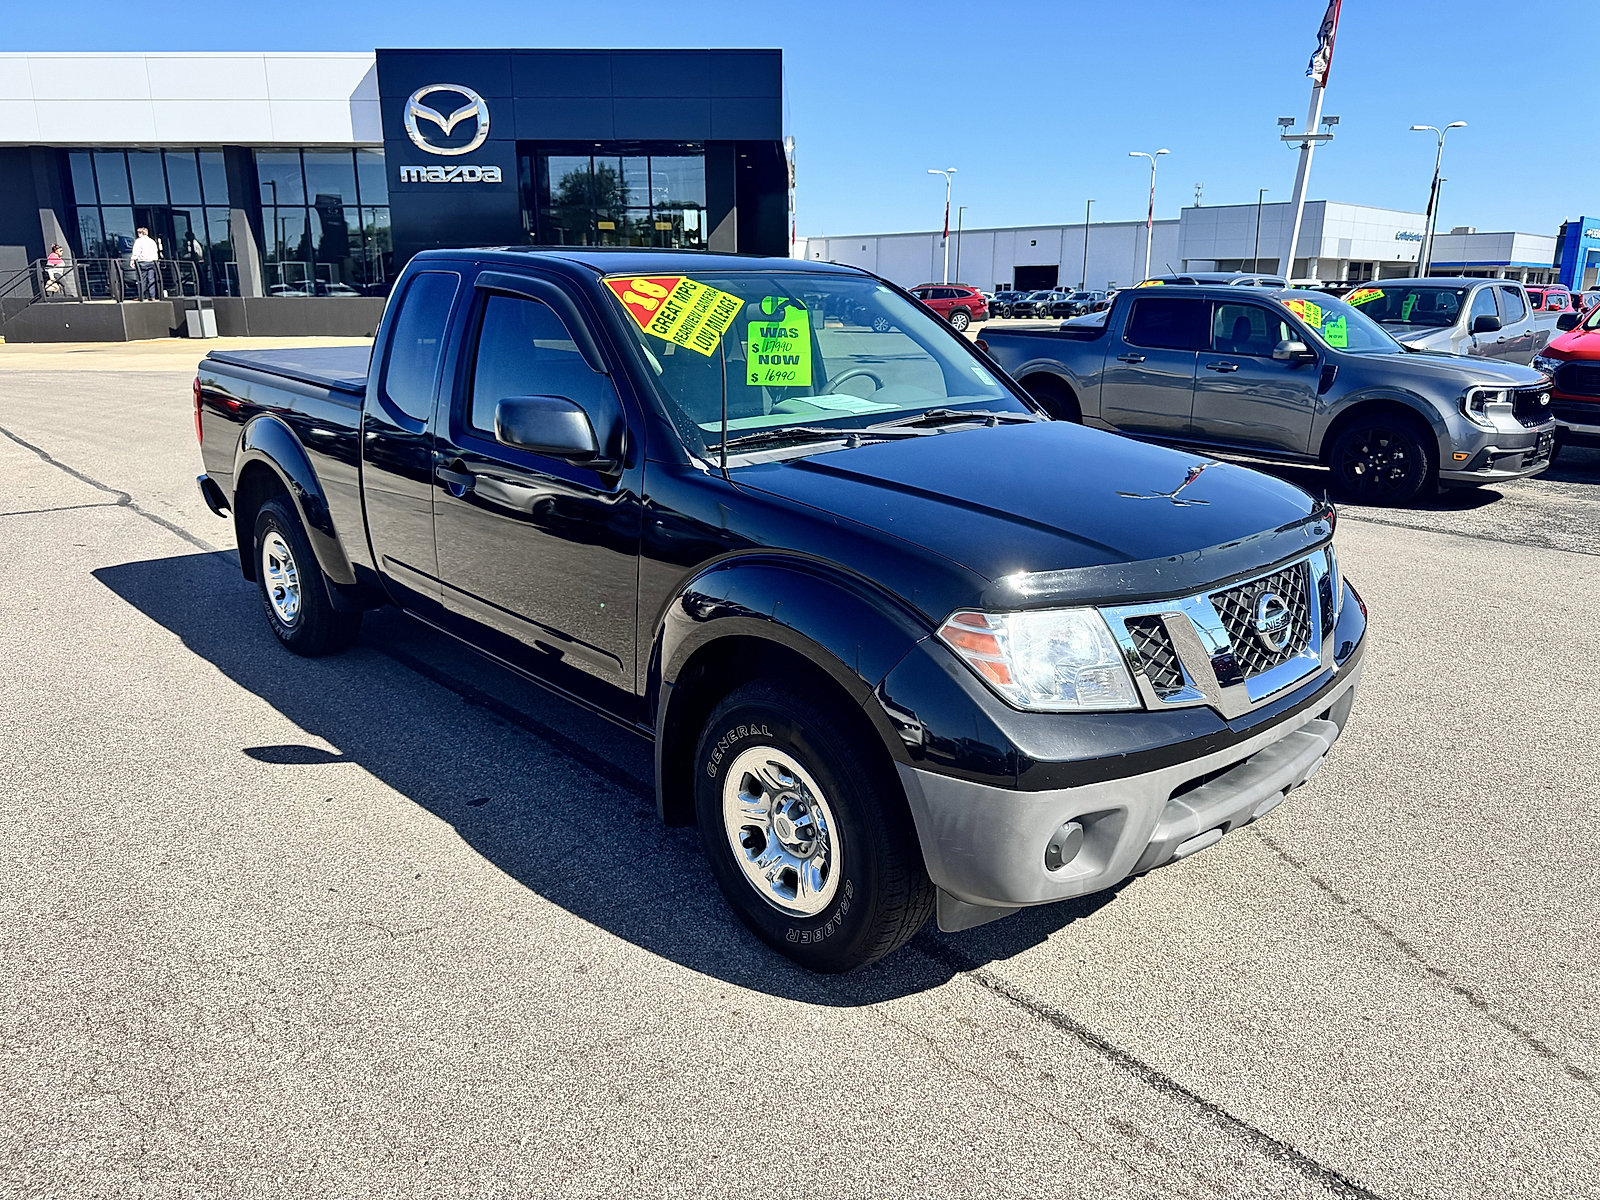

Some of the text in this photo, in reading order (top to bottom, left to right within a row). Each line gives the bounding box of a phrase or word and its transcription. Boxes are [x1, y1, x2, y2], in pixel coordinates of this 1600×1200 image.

[400, 165, 503, 183] mazda
[622, 279, 669, 311] 18
[651, 281, 698, 335] GREAT MPG
[672, 287, 719, 346] REARVIEW CAMERA
[693, 295, 738, 352] LOW MILEAGE
[759, 327, 799, 338] WAS
[751, 343, 760, 353] $
[758, 354, 800, 365] NOW
[750, 368, 796, 383] $ 16990
[706, 723, 774, 779] GENERAL
[786, 879, 855, 944] GRABBER
